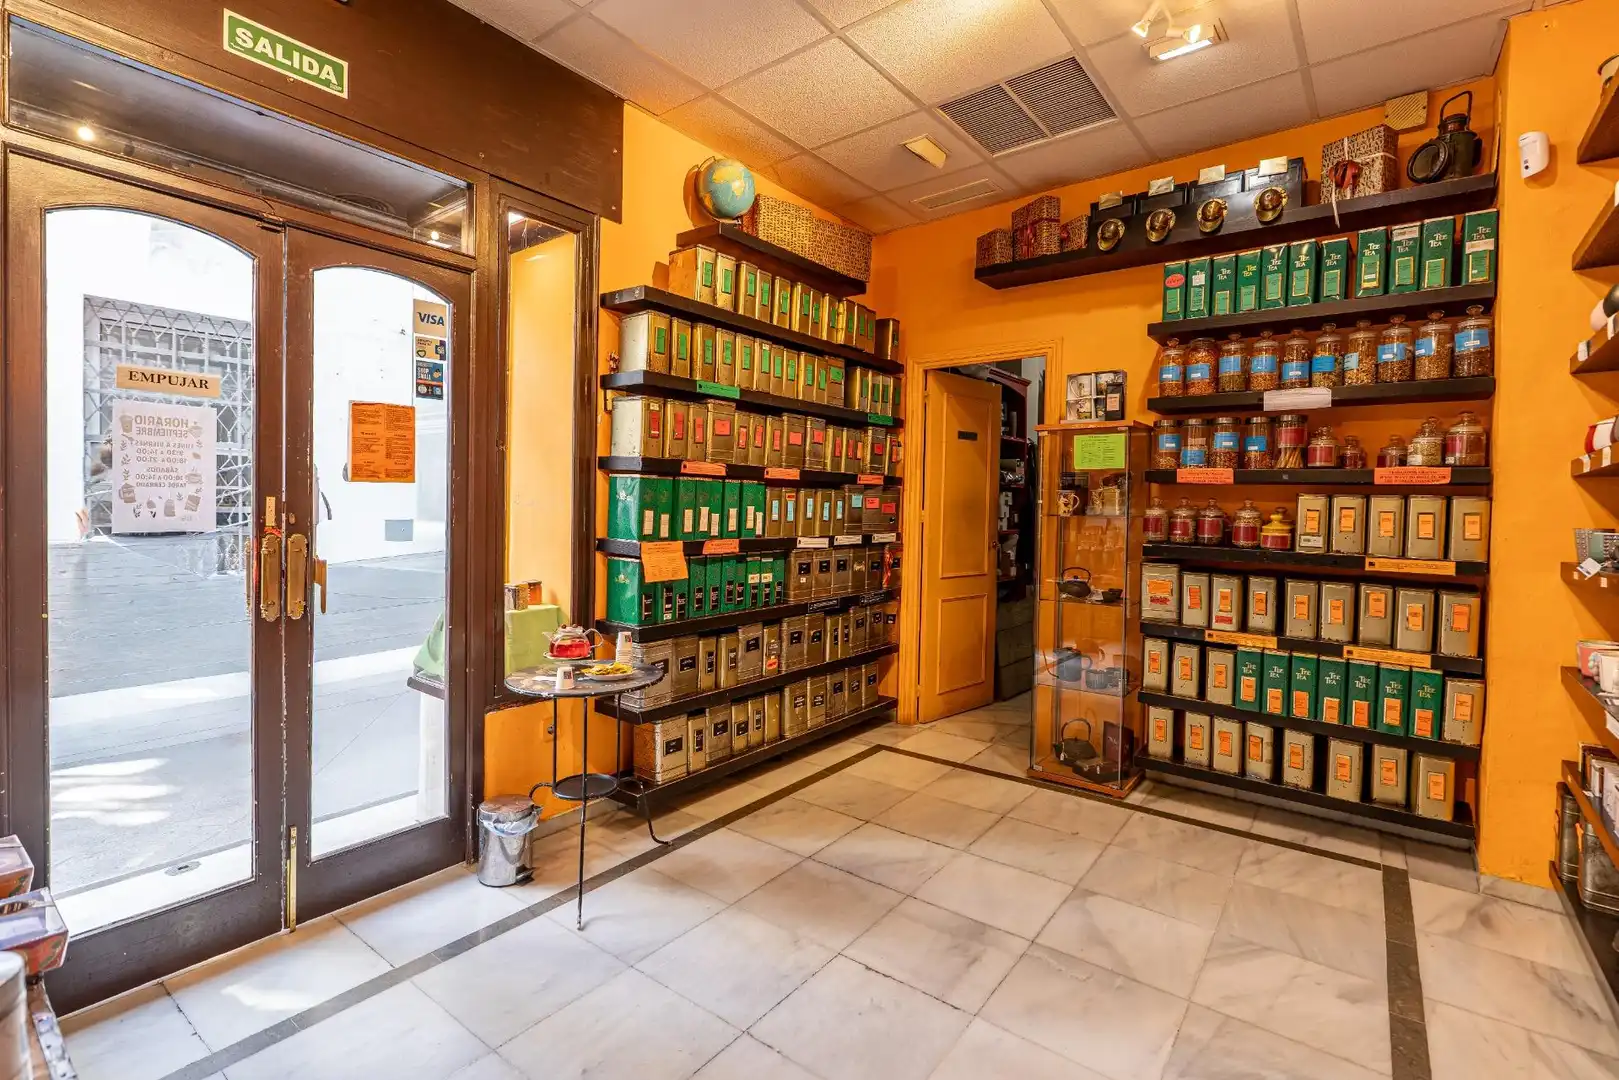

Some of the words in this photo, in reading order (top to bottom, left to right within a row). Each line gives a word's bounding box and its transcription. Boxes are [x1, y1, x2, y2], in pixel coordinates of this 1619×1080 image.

[235, 28, 338, 86] SALIDA
[417, 312, 444, 326] VISA
[128, 370, 209, 389] EMPUJAR
